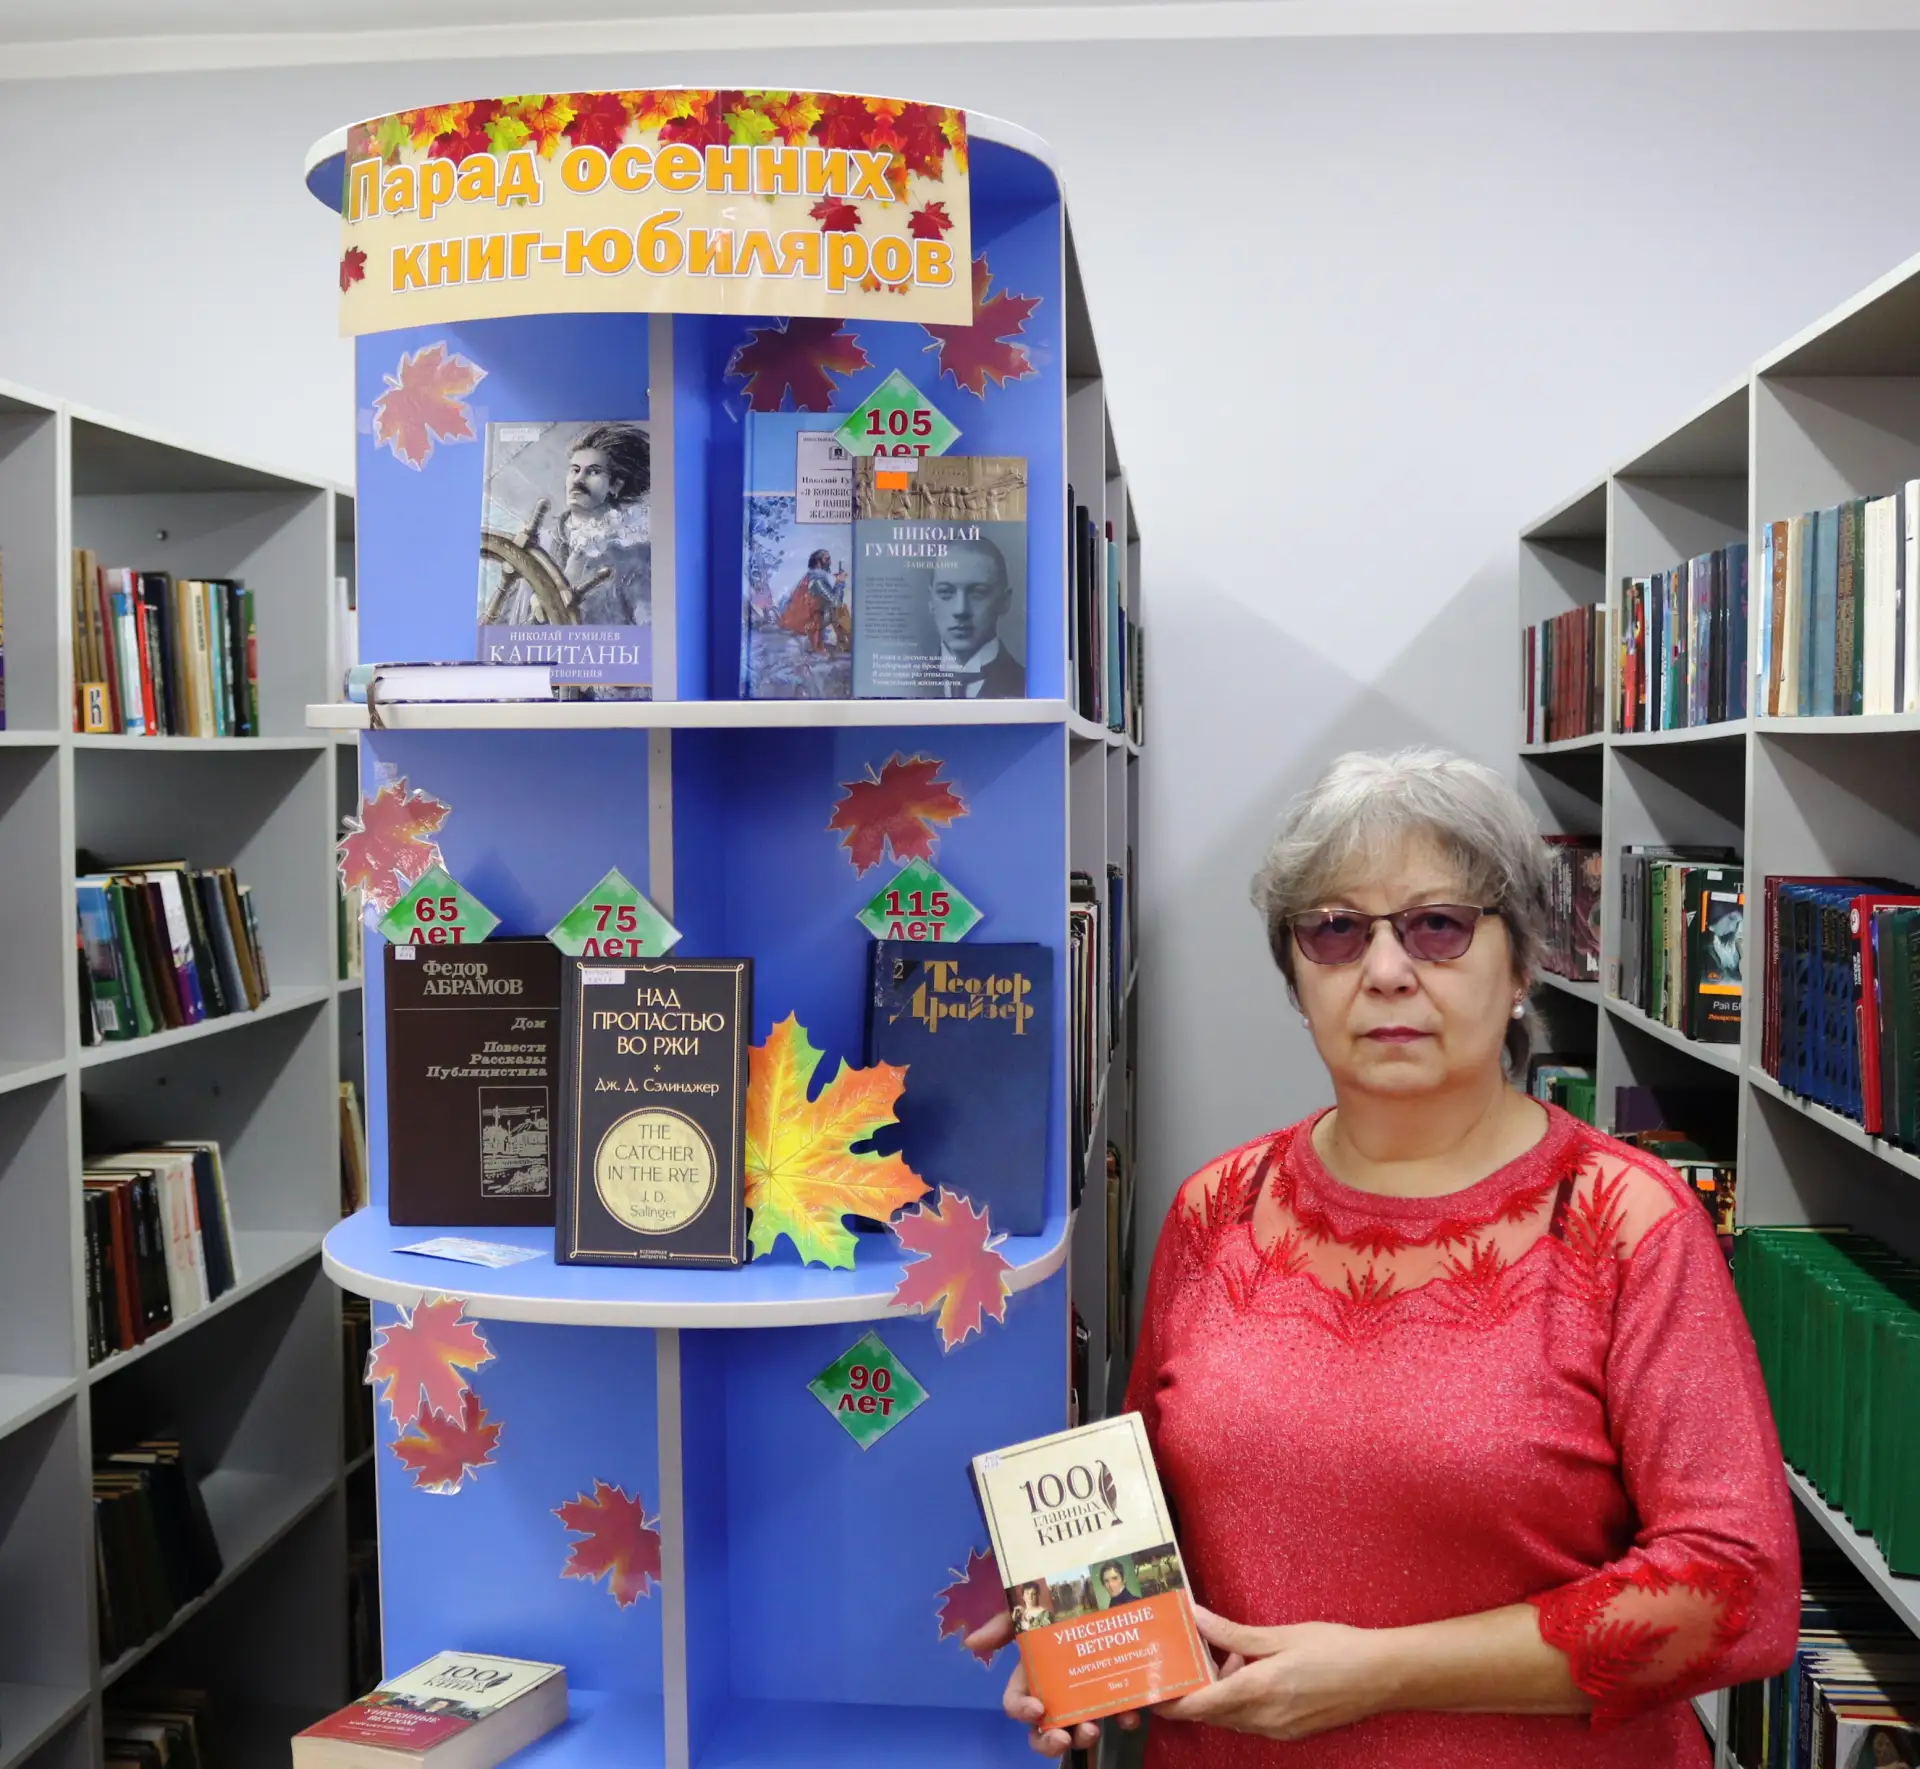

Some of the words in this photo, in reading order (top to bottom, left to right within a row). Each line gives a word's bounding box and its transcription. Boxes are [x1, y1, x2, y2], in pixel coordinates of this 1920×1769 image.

[349, 149, 543, 223] Парад
[560, 143, 895, 201] осенних
[391, 209, 955, 293] книг-юбиляров
[866, 408, 932, 436] 105
[872, 443, 931, 456] лет
[813, 488, 852, 496] КОНКВИС
[823, 500, 851, 508] ПАНЦИ
[810, 511, 852, 519] ЖЕЛЕЗНО
[892, 525, 981, 541] НИКОЛАЙ
[864, 543, 948, 557] ГУМИЛЕВ
[510, 631, 562, 641] НИКОЛАЙ
[568, 631, 621, 641] ГУМИЛЕВ
[489, 645, 640, 665] КАПИТАНЫ
[415, 897, 459, 922] 65
[885, 890, 950, 917] 115
[592, 904, 637, 932] 75
[408, 926, 465, 944] лет
[887, 921, 946, 942] лет
[581, 937, 644, 957] лет
[422, 960, 488, 979] Федор
[422, 979, 523, 996] АБРАМОВ
[924, 960, 1032, 1003] Теодор
[637, 988, 681, 1009] НАД
[889, 981, 1034, 1035] Драйзер
[511, 1018, 546, 1031] Дом
[592, 1012, 725, 1032] ПРОПАСТЬЮ
[483, 1042, 547, 1053] Повести
[617, 1036, 647, 1055] ВО
[653, 1037, 699, 1056] РЖИ
[469, 1054, 547, 1065] Рассказы
[426, 1066, 547, 1080] Публицистика
[595, 1078, 621, 1092] Дж.
[624, 1078, 639, 1093] Д.
[643, 1079, 719, 1096] Сэлинджер
[638, 1124, 671, 1140] THE
[615, 1145, 694, 1161] CATCHER
[608, 1166, 624, 1180] IN
[631, 1166, 662, 1182] THE
[669, 1168, 699, 1183] RYE
[641, 1191, 649, 1202] J.
[654, 1192, 666, 1203] D.
[630, 1205, 676, 1221] Salinger
[849, 1365, 891, 1393] 90
[838, 1393, 895, 1416] лет
[1019, 1465, 1095, 1513] 100
[1033, 1500, 1101, 1527] главных
[1037, 1511, 1107, 1546] КНИГ
[1054, 1606, 1154, 1644] УНЕСЕННЫЕ
[1076, 1628, 1140, 1657] ВЕТРОМ
[441, 1665, 498, 1681] 100
[1068, 1657, 1112, 1676] МАРГАРЕТ
